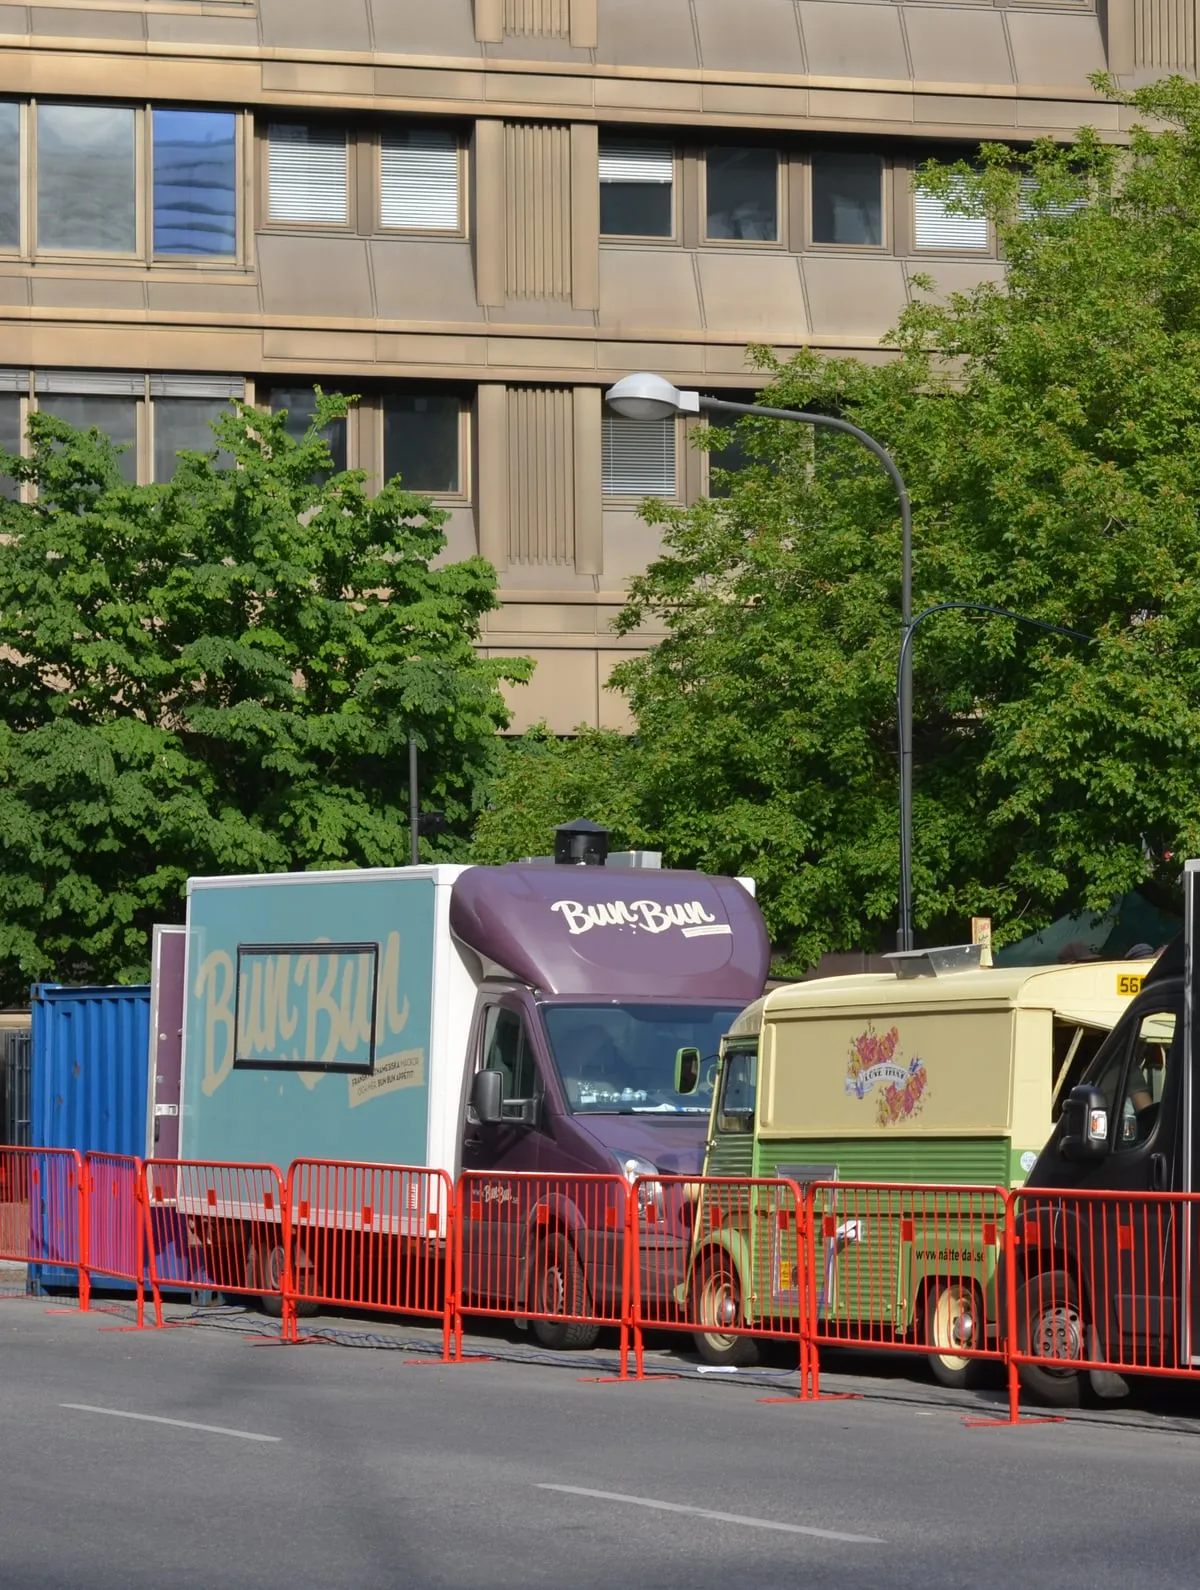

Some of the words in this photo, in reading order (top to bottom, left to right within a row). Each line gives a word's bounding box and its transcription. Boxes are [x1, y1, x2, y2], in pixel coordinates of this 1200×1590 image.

[550, 900, 639, 934] Bun
[630, 900, 715, 934] Bun
[1120, 977, 1147, 993] 56
[195, 949, 298, 1097] Bun
[294, 930, 410, 1090] Bun
